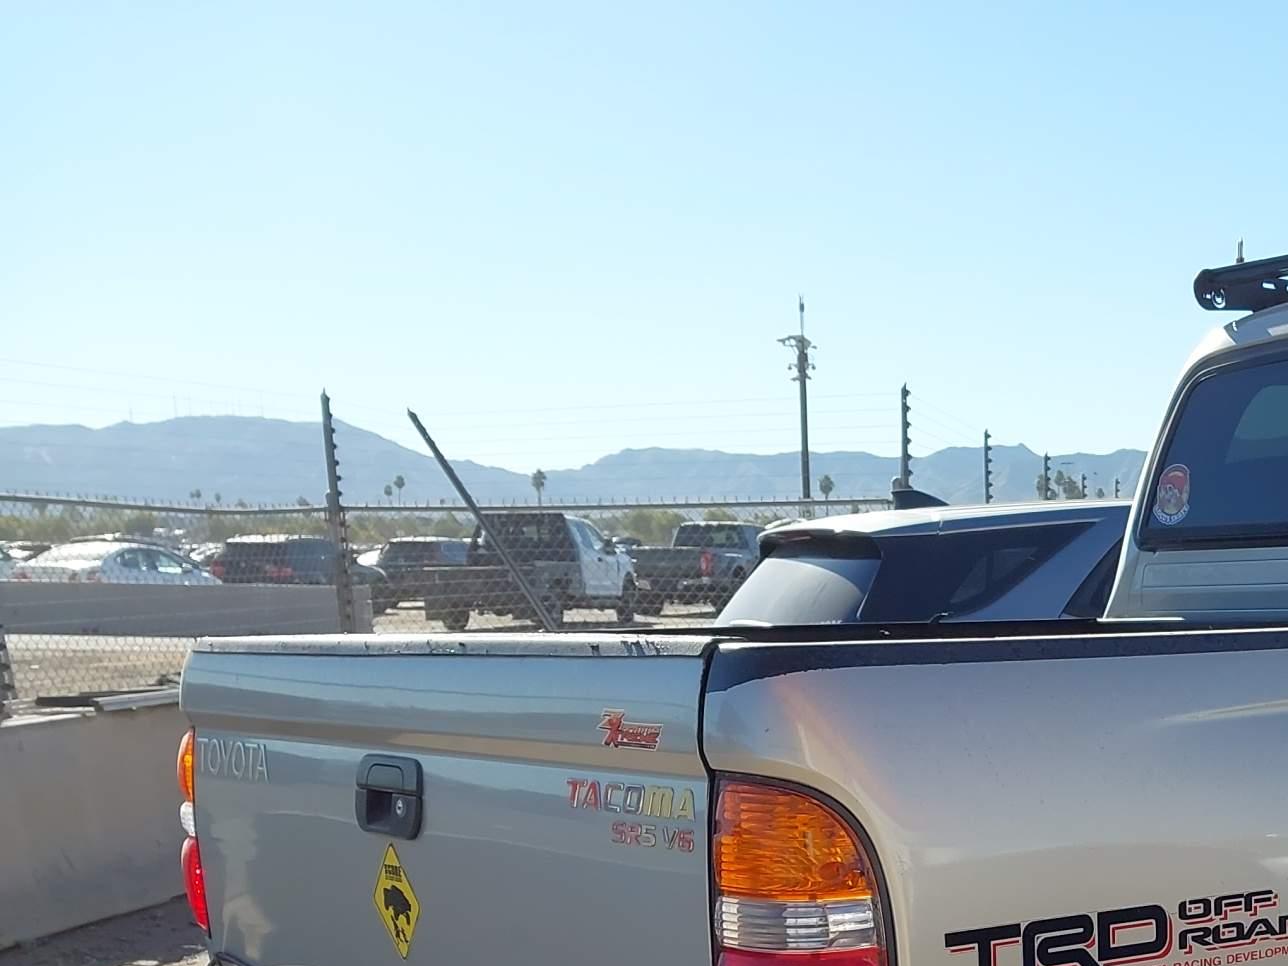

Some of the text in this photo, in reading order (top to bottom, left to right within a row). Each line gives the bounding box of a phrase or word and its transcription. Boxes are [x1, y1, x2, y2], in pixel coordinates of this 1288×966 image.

[197, 737, 270, 783] TOYOTA
[566, 777, 696, 823] TACOMA
[610, 821, 695, 853] SR5 V6
[1178, 889, 1279, 925] OFF
